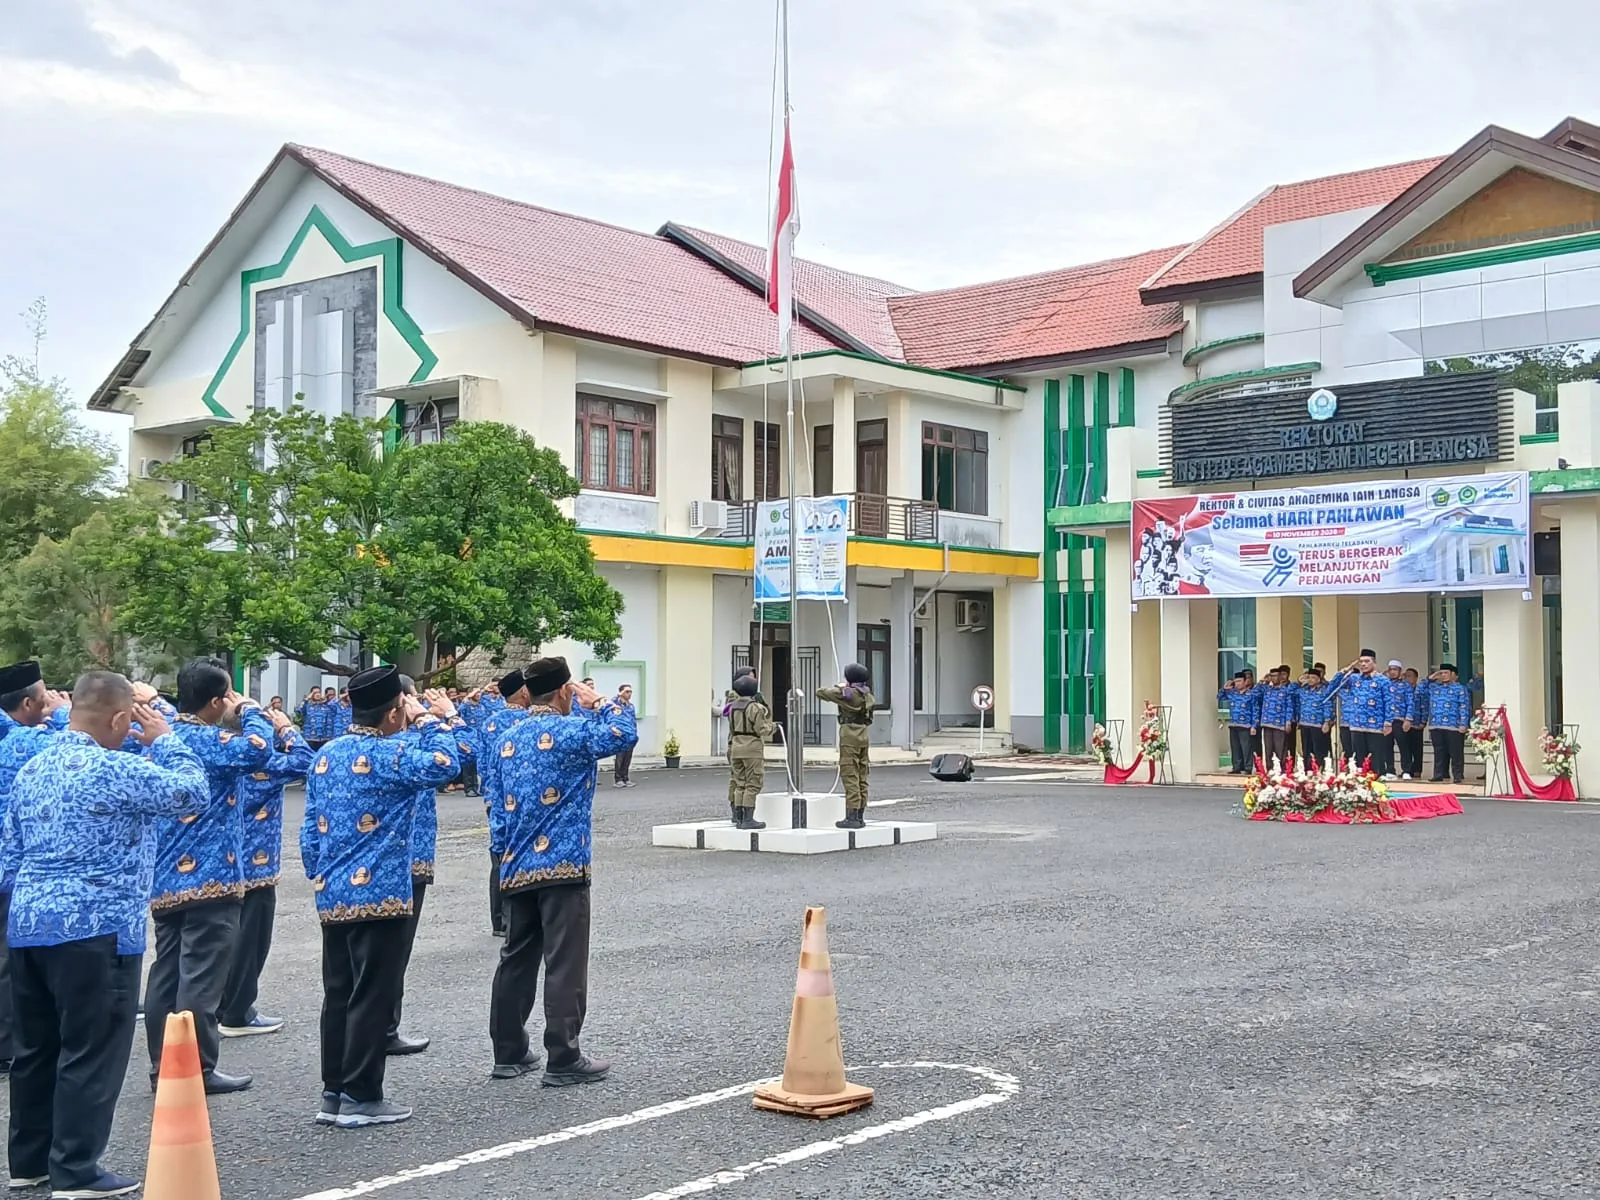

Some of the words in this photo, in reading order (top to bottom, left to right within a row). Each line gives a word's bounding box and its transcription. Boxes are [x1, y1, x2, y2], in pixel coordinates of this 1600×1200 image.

[1280, 421, 1366, 449] REKTORAT
[1301, 446, 1350, 471] ISLAM
[1355, 439, 1415, 467] NEGERI
[1419, 432, 1492, 462] LANGSA
[1199, 500, 1235, 511] REKTOR
[1238, 498, 1244, 509] &
[1247, 495, 1285, 508] CIVITAS
[1288, 492, 1349, 505] AKADEMIKA
[1352, 489, 1375, 501] IAIN
[1379, 486, 1420, 499] LANGSA
[1212, 513, 1273, 530] Selamat
[1277, 510, 1313, 527] HARI
[1316, 504, 1405, 525] PAHLAWAN
[1280, 529, 1320, 538] NOVEMBER
[1298, 549, 1336, 561] TERUS
[1339, 546, 1403, 559] BERGERAK
[1298, 559, 1390, 573] MELANJUTKAN
[1298, 572, 1381, 585] PERJUANGAN
